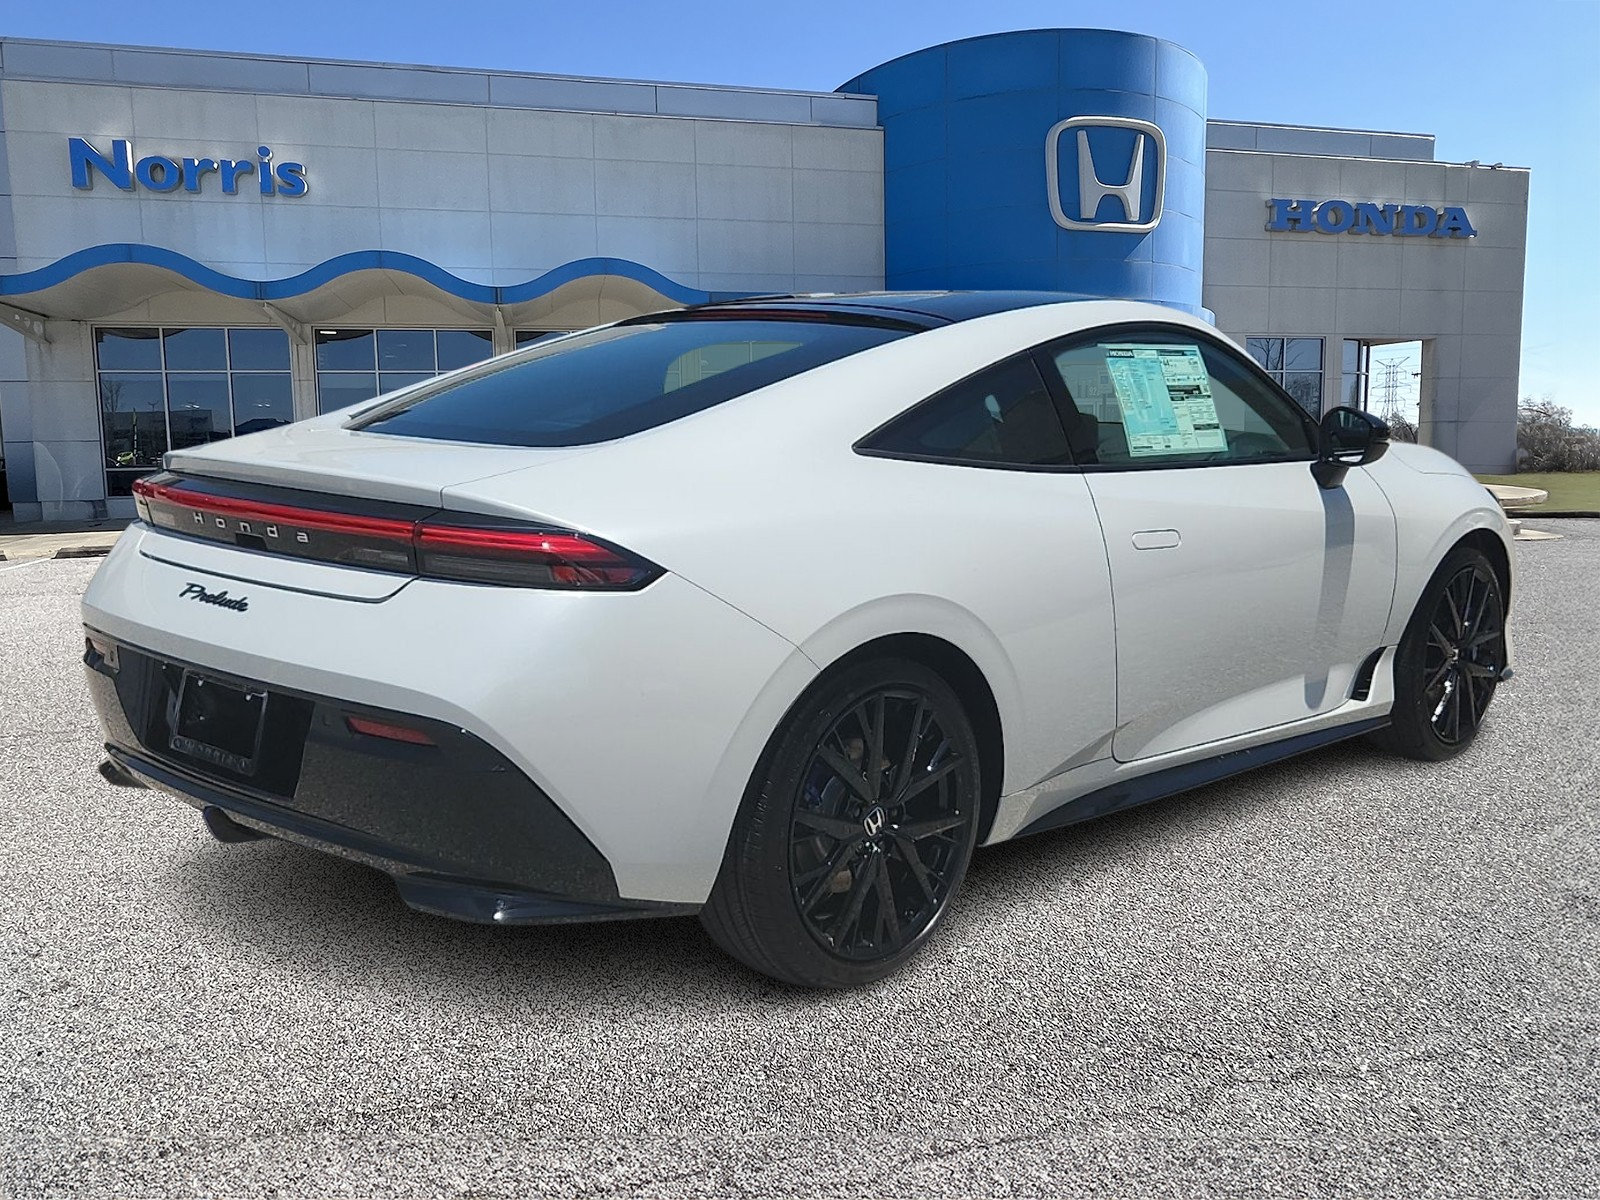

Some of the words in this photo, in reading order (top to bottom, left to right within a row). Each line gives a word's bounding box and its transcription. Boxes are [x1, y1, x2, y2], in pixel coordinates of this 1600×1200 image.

[67, 137, 310, 197] Norris
[1265, 198, 1478, 238] HONDA
[193, 512, 309, 543] Honda
[179, 582, 249, 612] Prelude
